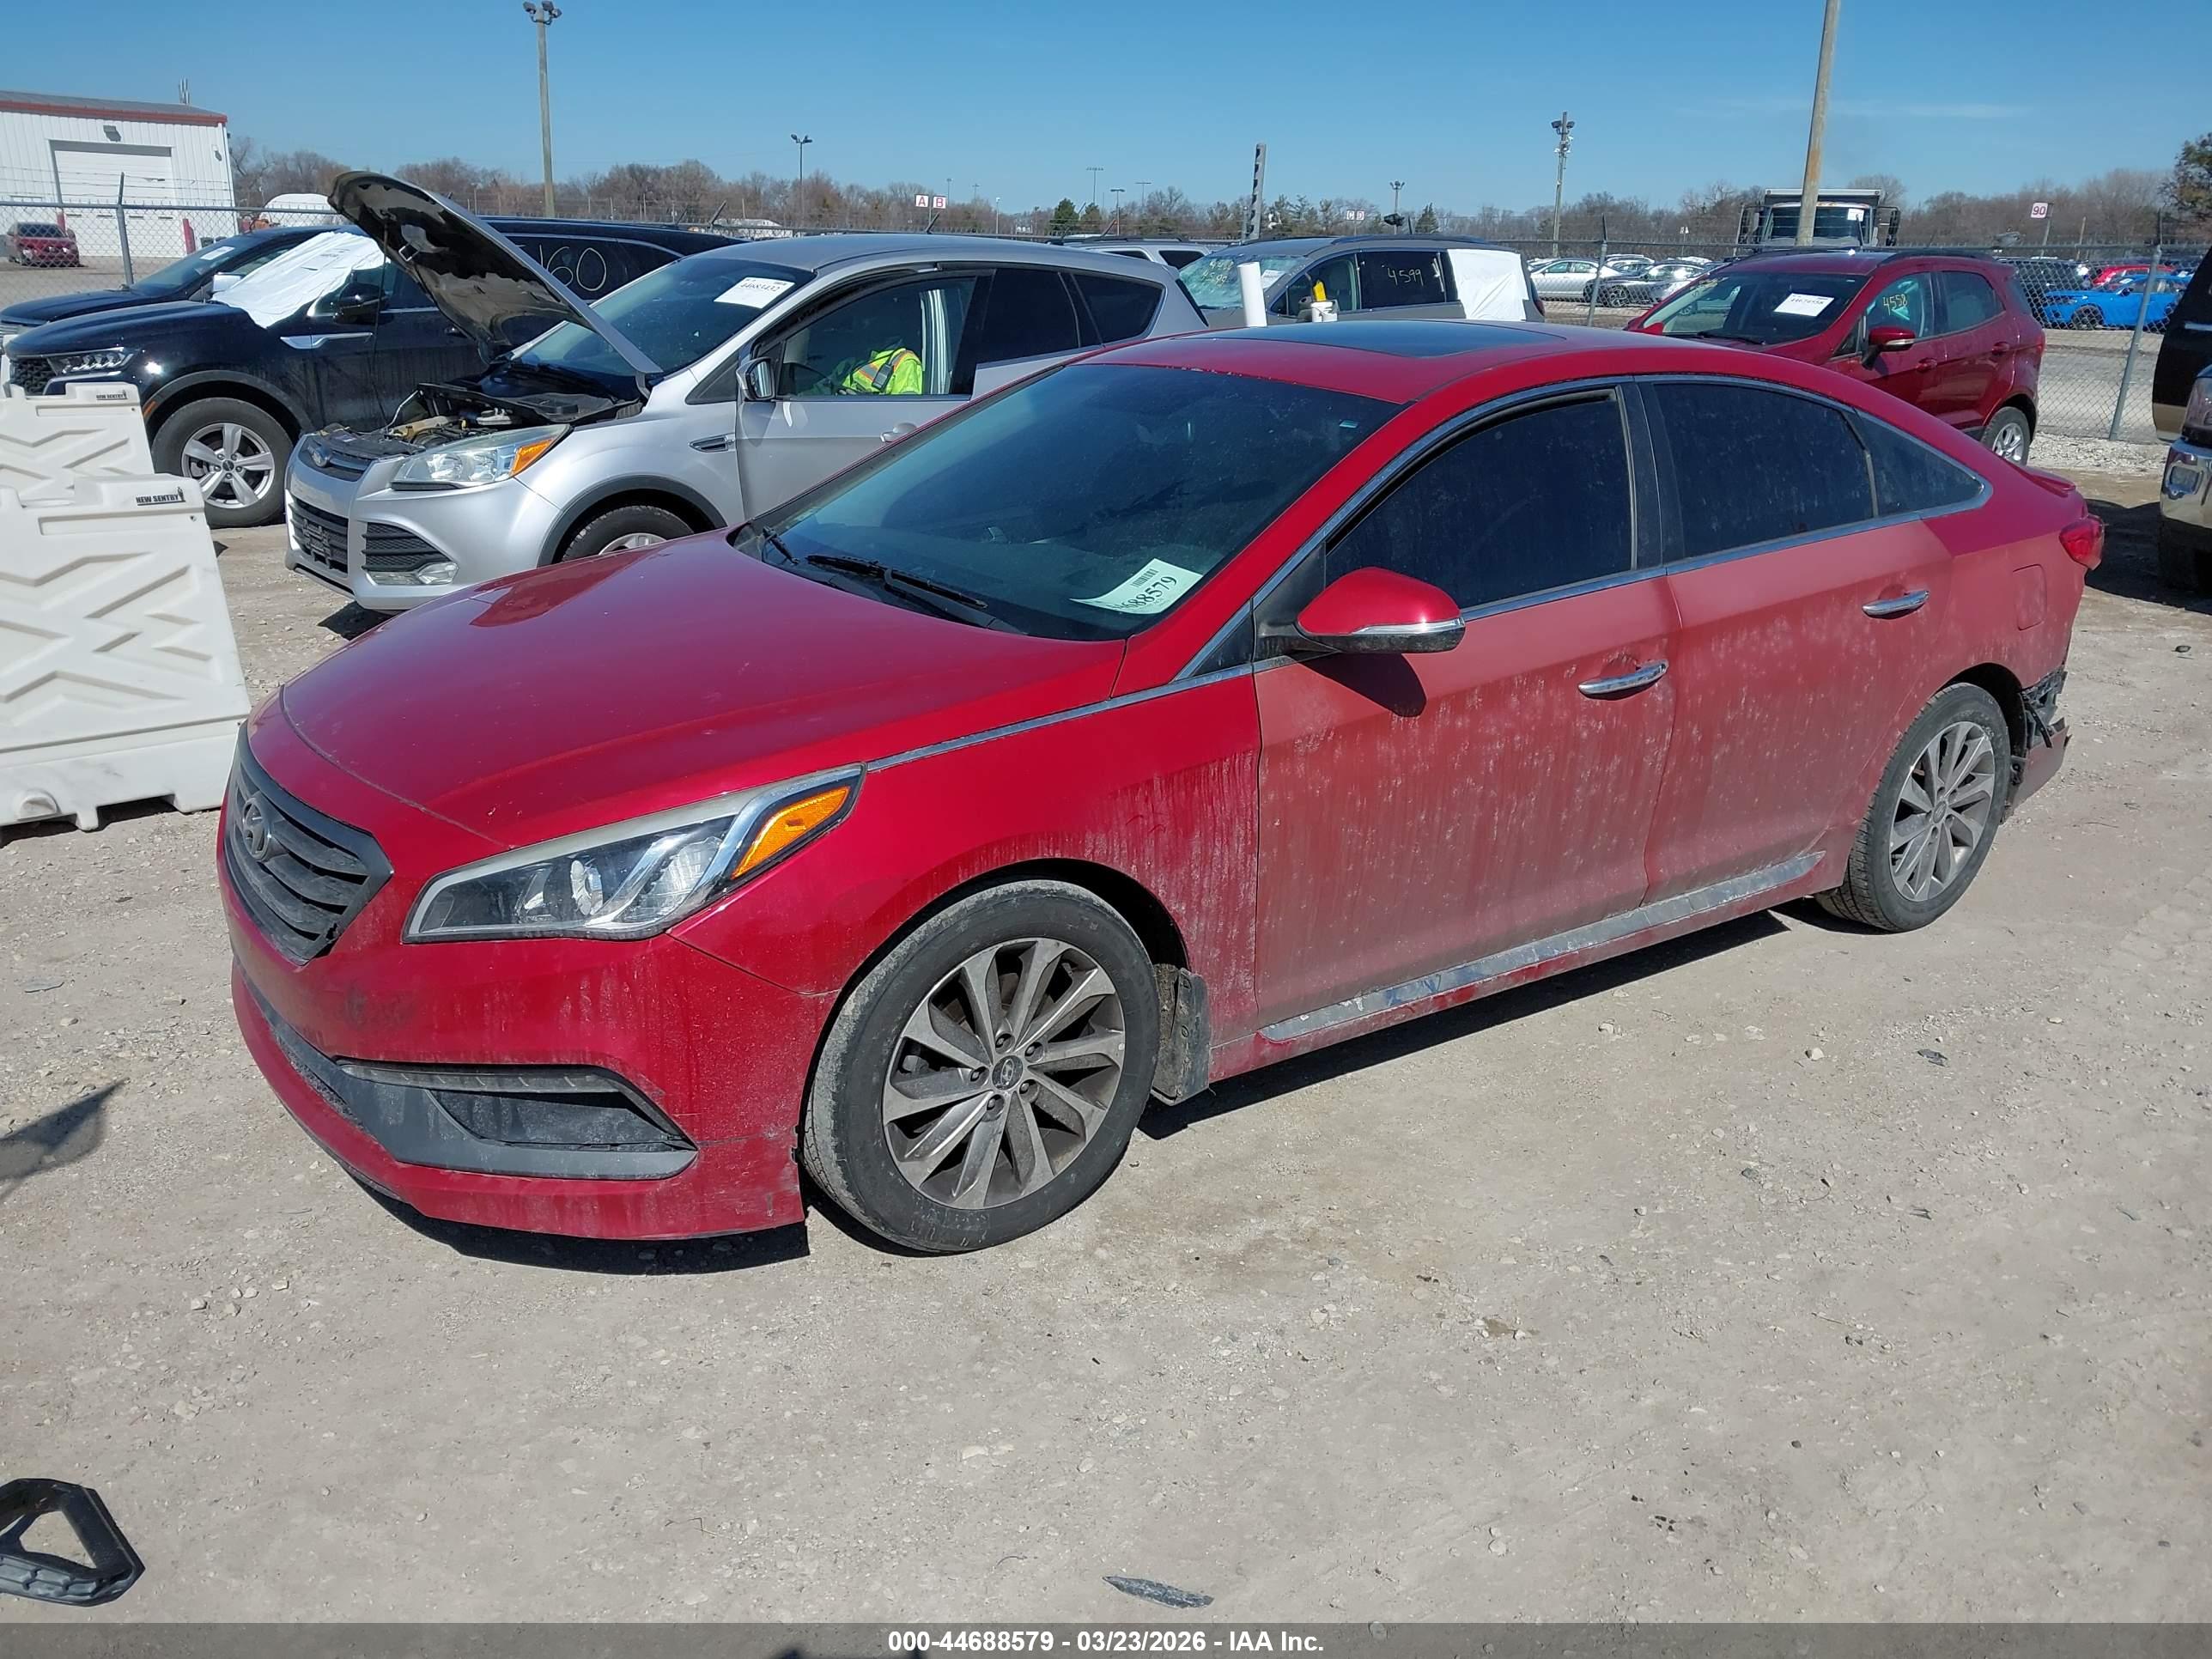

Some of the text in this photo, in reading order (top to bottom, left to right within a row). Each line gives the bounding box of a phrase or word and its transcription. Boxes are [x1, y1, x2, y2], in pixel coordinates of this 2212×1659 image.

[918, 196, 927, 206] A
[936, 198, 944, 207] B
[2033, 205, 2046, 216] 90
[1387, 267, 1424, 286] 4599
[152, 494, 179, 502] SENTRY
